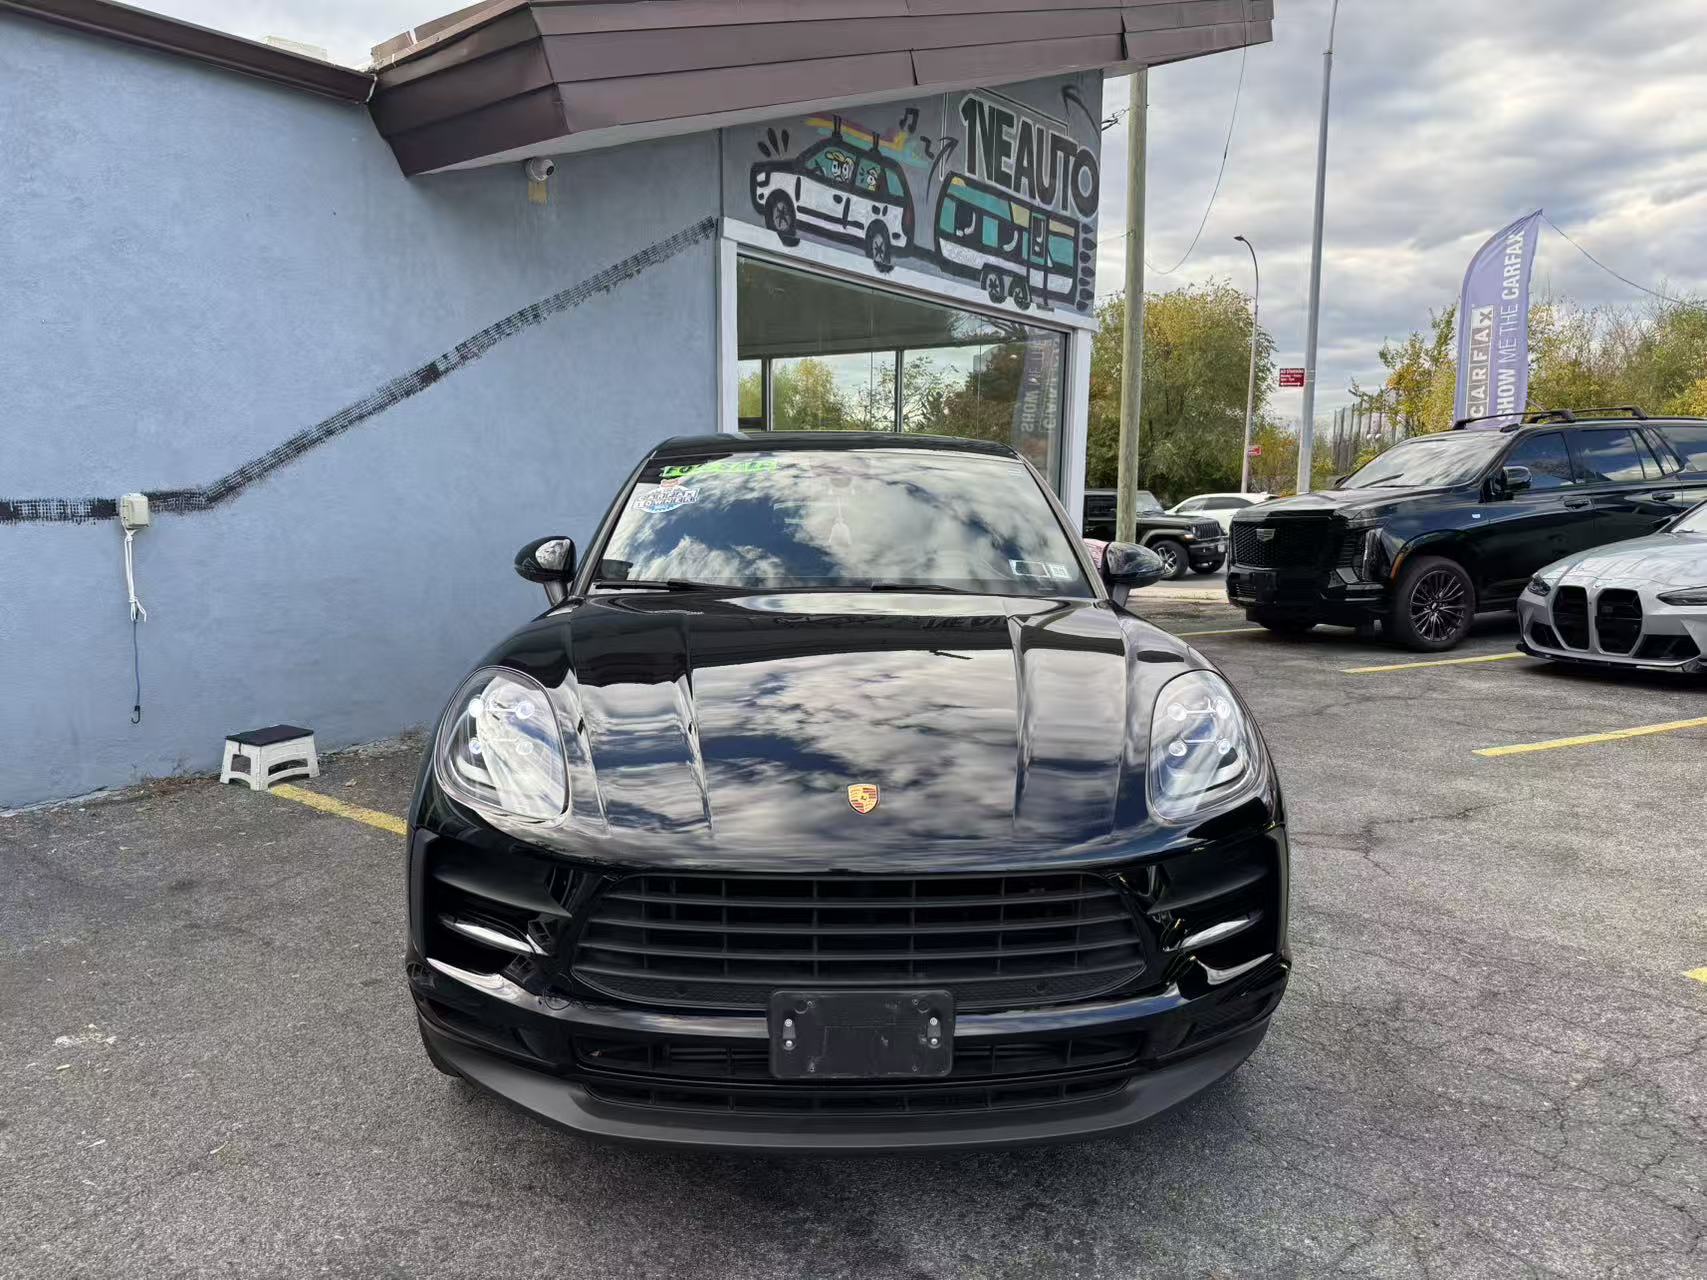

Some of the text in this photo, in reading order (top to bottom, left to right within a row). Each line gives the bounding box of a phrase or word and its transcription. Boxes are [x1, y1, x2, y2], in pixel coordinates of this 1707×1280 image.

[1469, 308, 1493, 418] CARFAX
[1497, 230, 1525, 420] SHOW ME THE CARFAX
